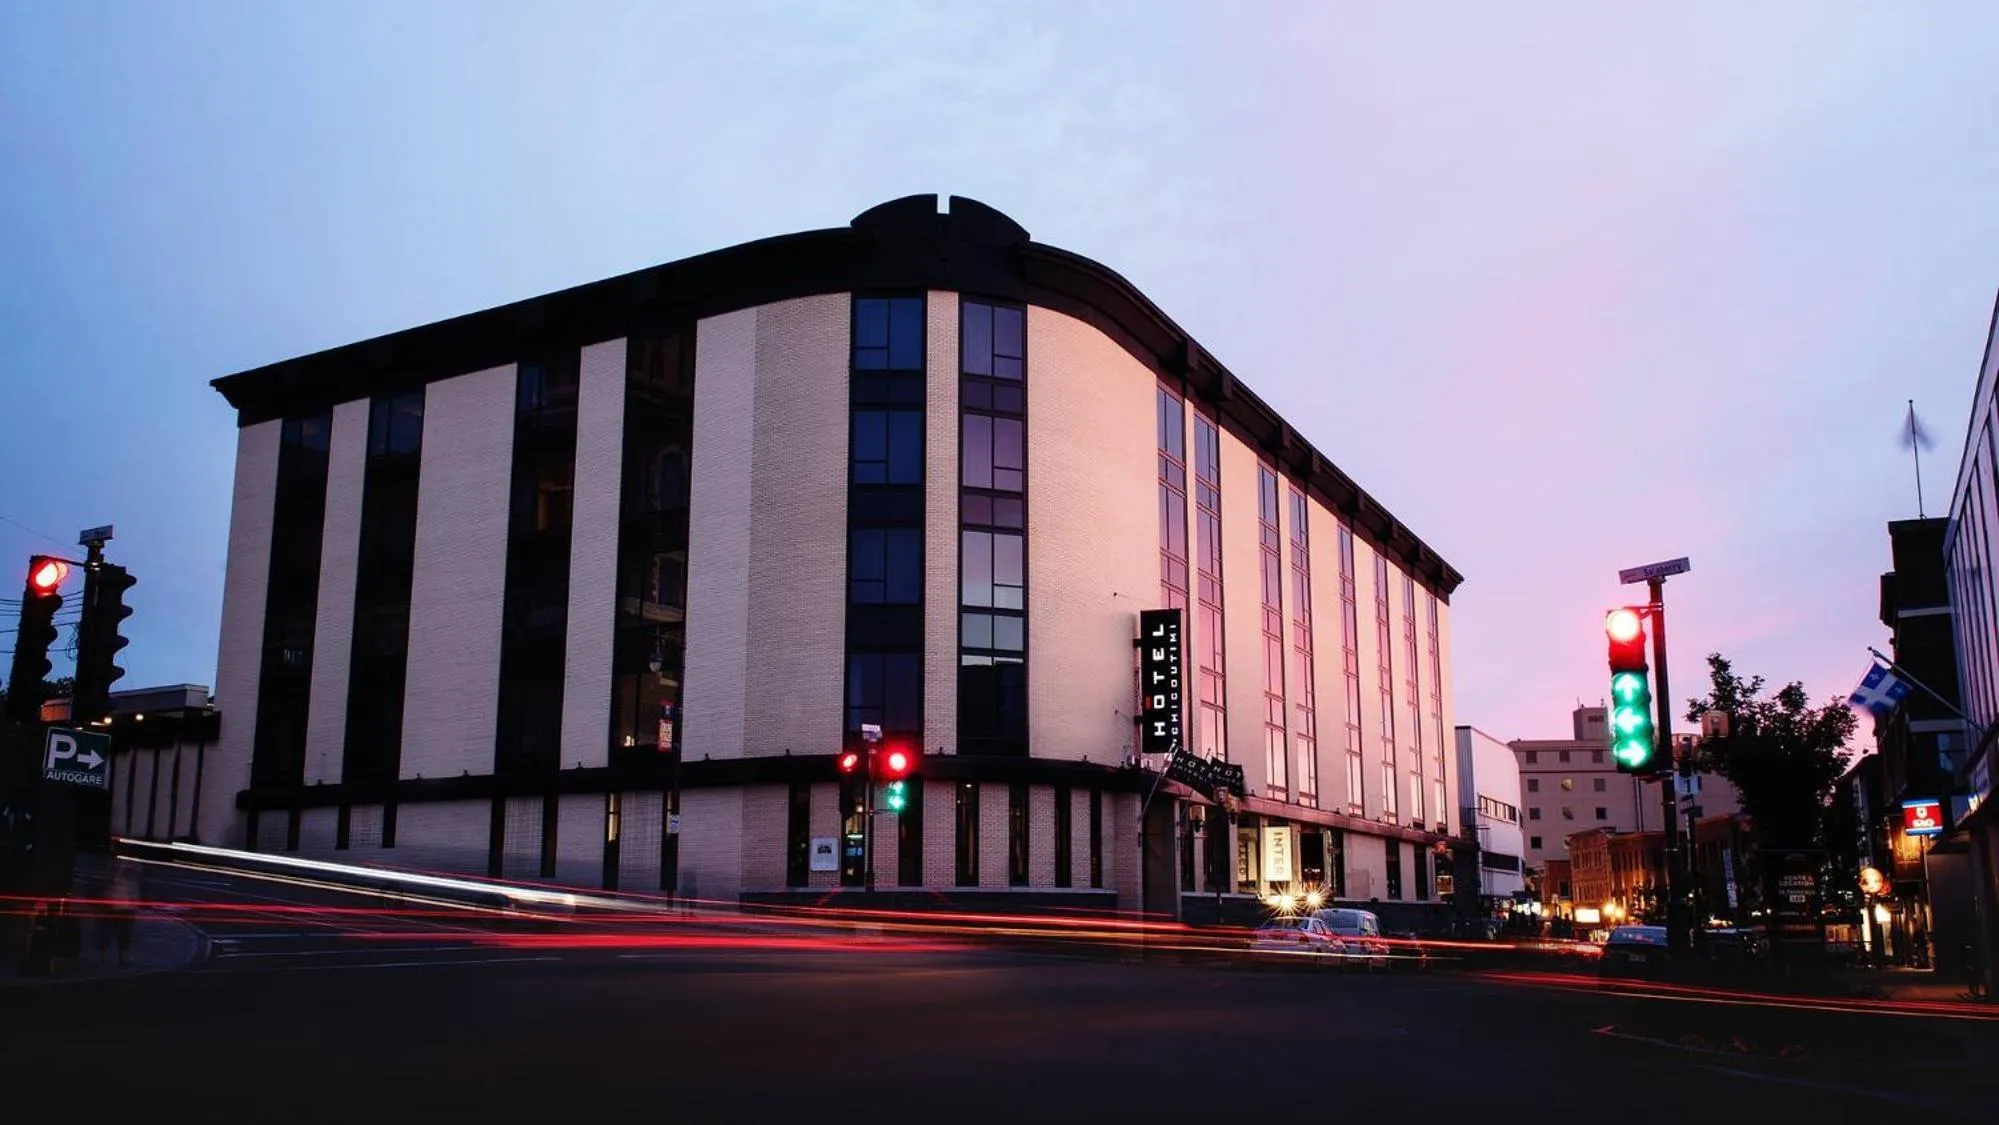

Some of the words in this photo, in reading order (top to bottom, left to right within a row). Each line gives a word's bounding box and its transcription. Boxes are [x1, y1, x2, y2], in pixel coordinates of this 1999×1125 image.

[1169, 624, 1179, 736] CHICOUTIMI
[47, 733, 78, 769] P
[46, 770, 103, 785] AUTOGARE
